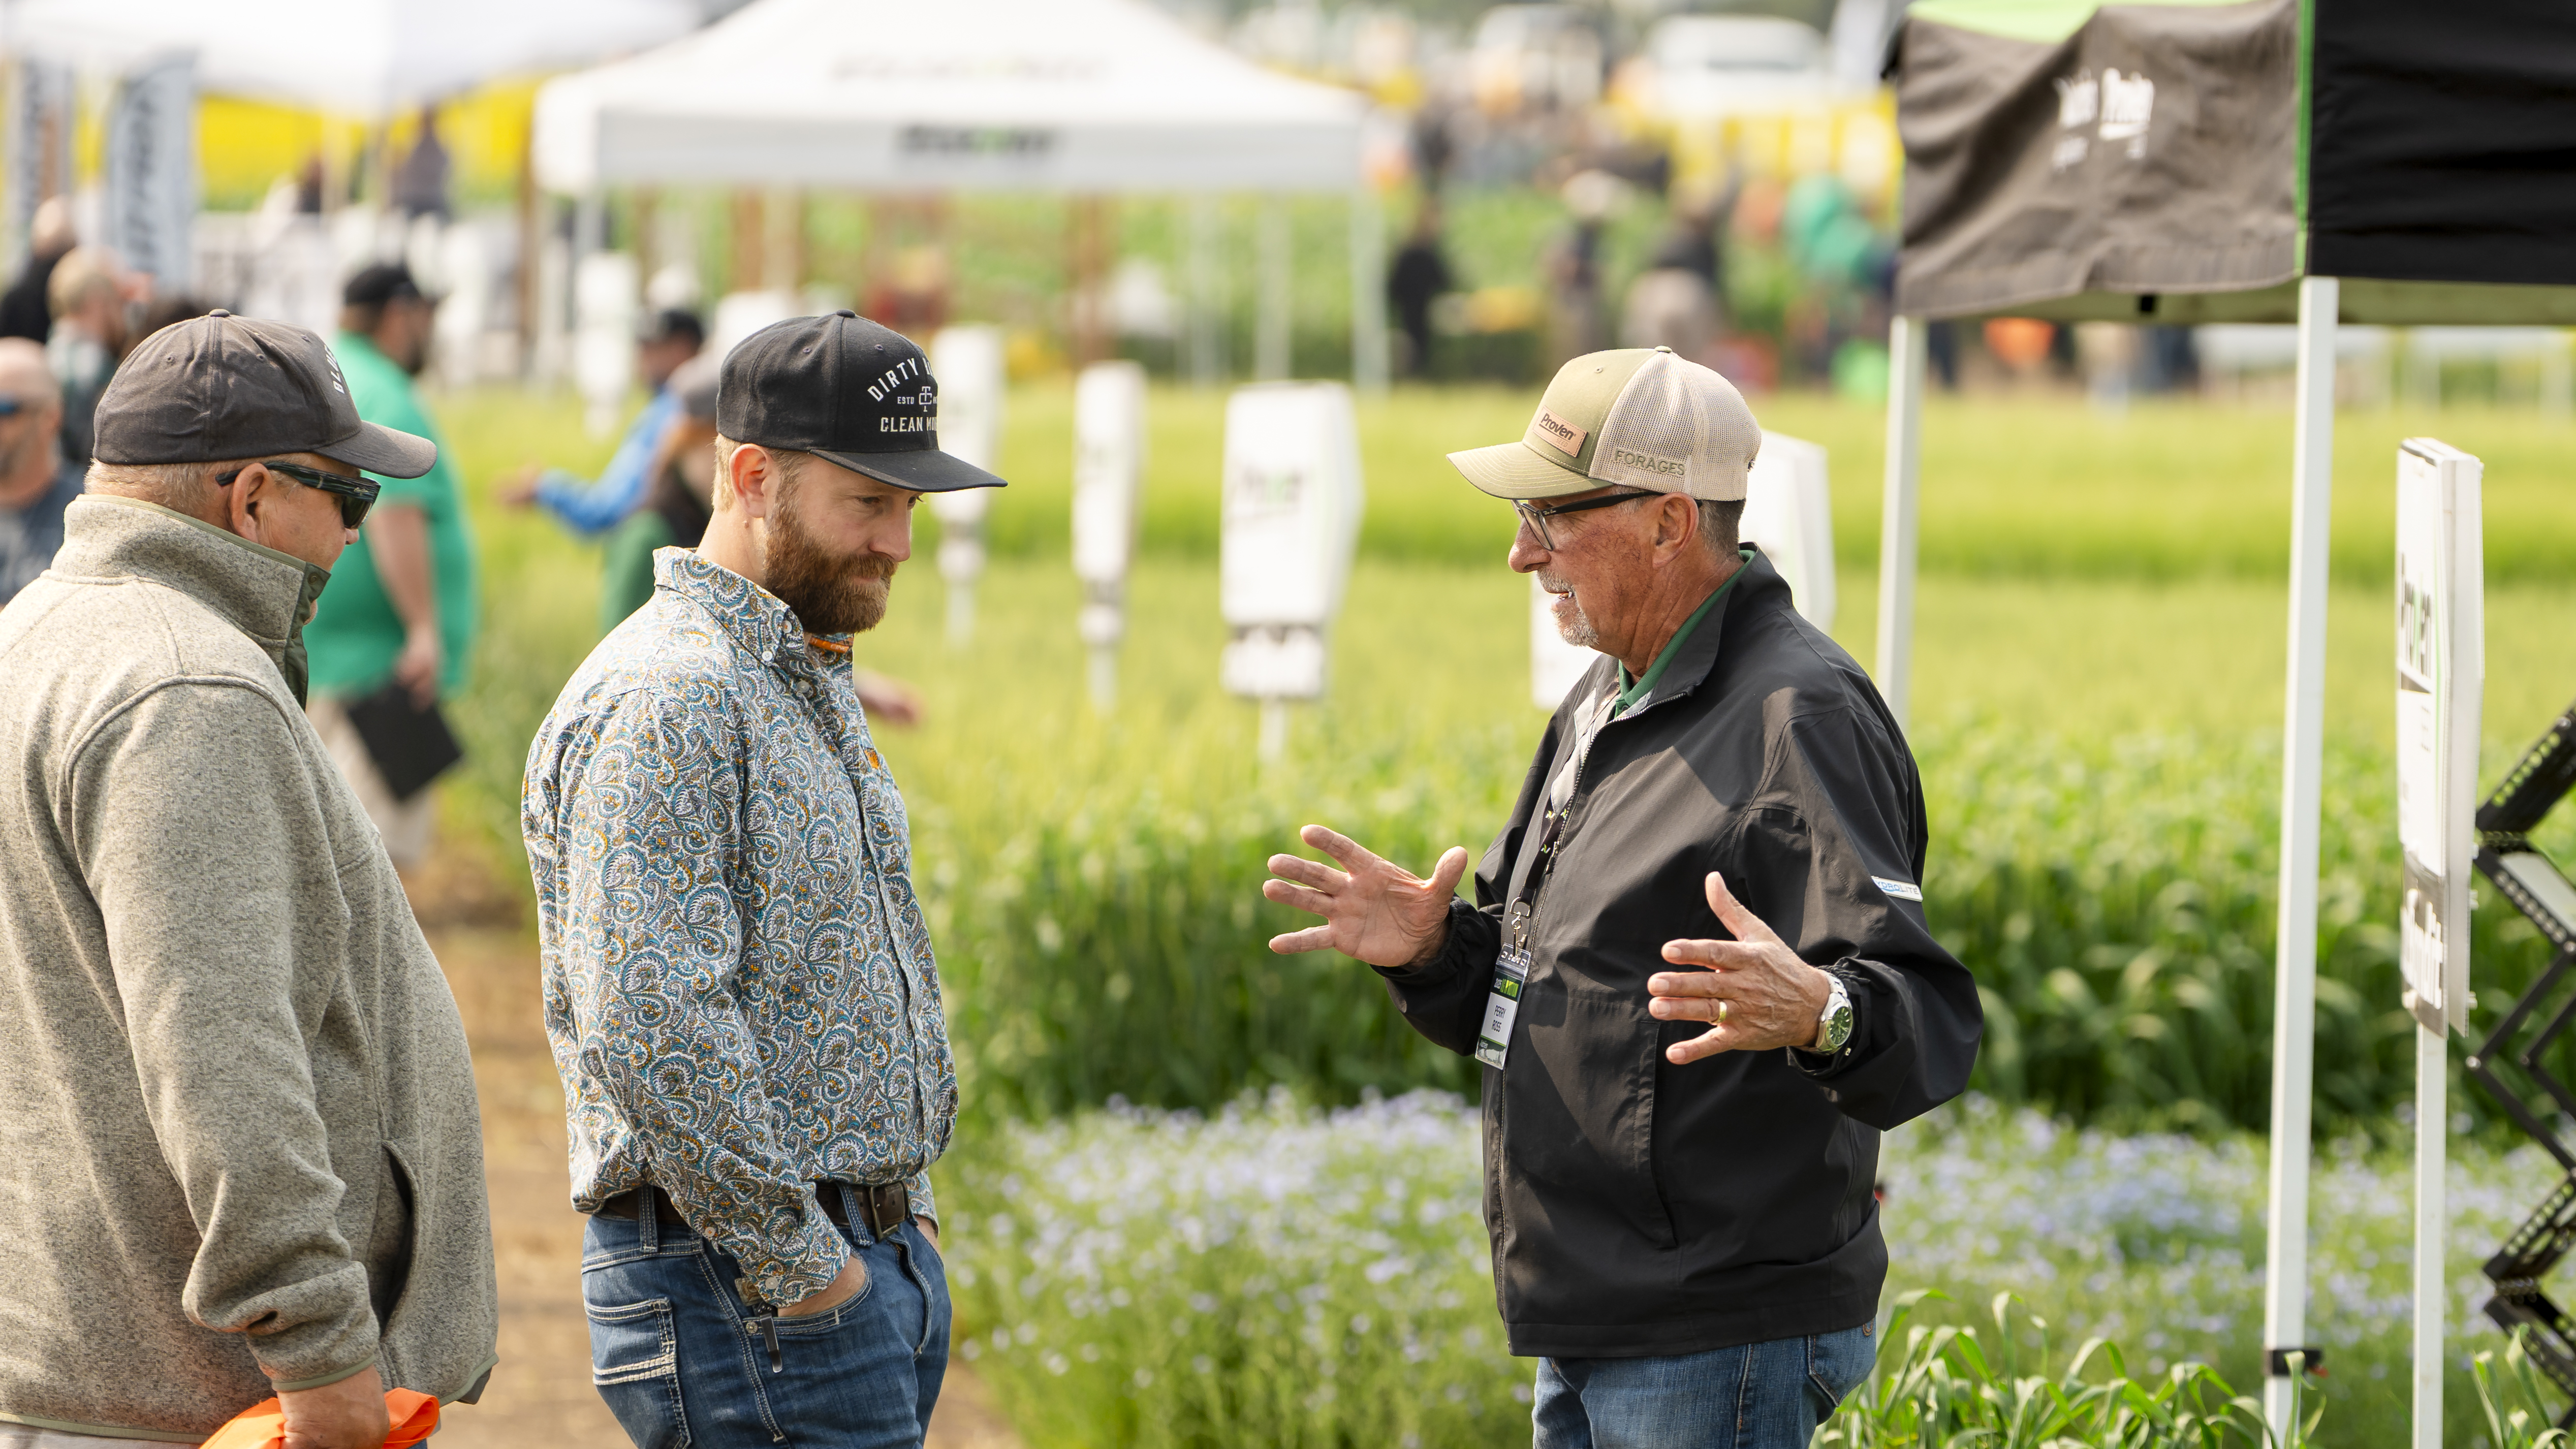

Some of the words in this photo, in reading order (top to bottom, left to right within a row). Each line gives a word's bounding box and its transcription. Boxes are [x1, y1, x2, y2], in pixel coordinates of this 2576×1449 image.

[867, 358, 919, 402] DIRTY
[897, 396, 915, 404] ESTD
[881, 417, 923, 432] CLEAN
[1556, 437, 1568, 448] SEED
[1615, 448, 1685, 476] FORAGES
[1875, 880, 1920, 895] YDROLITE
